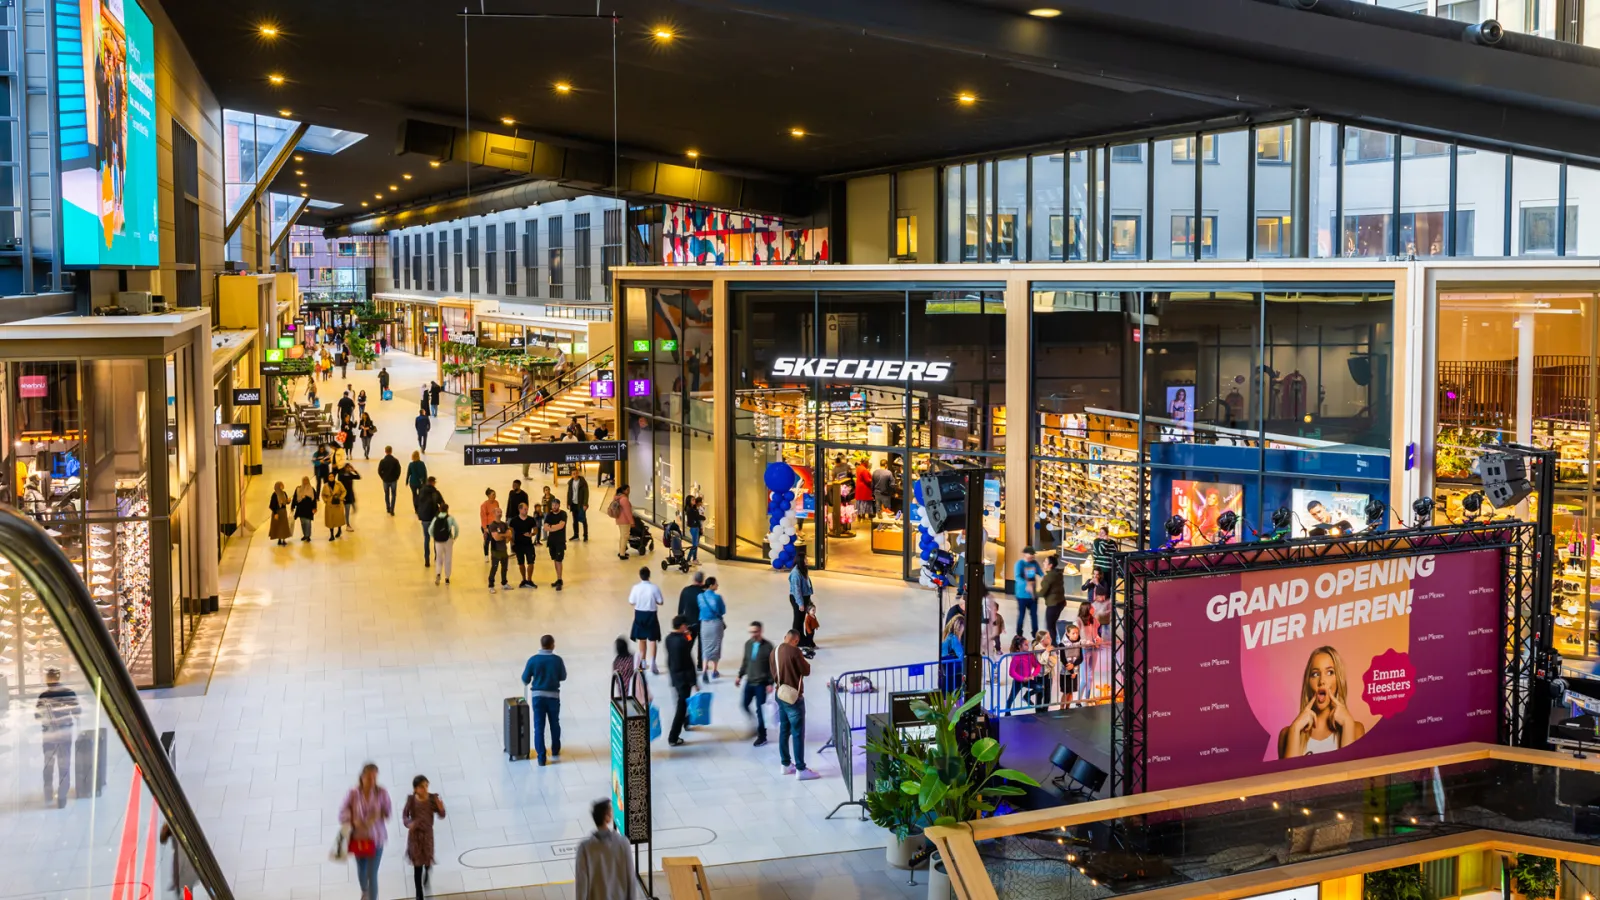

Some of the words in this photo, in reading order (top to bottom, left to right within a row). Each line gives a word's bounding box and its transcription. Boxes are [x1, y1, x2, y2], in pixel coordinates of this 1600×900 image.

[771, 356, 952, 382] SKECHERS
[220, 430, 244, 440] snipes
[1206, 577, 1310, 623] GRAND
[1315, 554, 1436, 599] OPENING
[1242, 613, 1308, 650] VIER
[1312, 589, 1415, 636] MEREN!
[1372, 669, 1406, 681] Emma
[1367, 680, 1410, 694] Heesters
